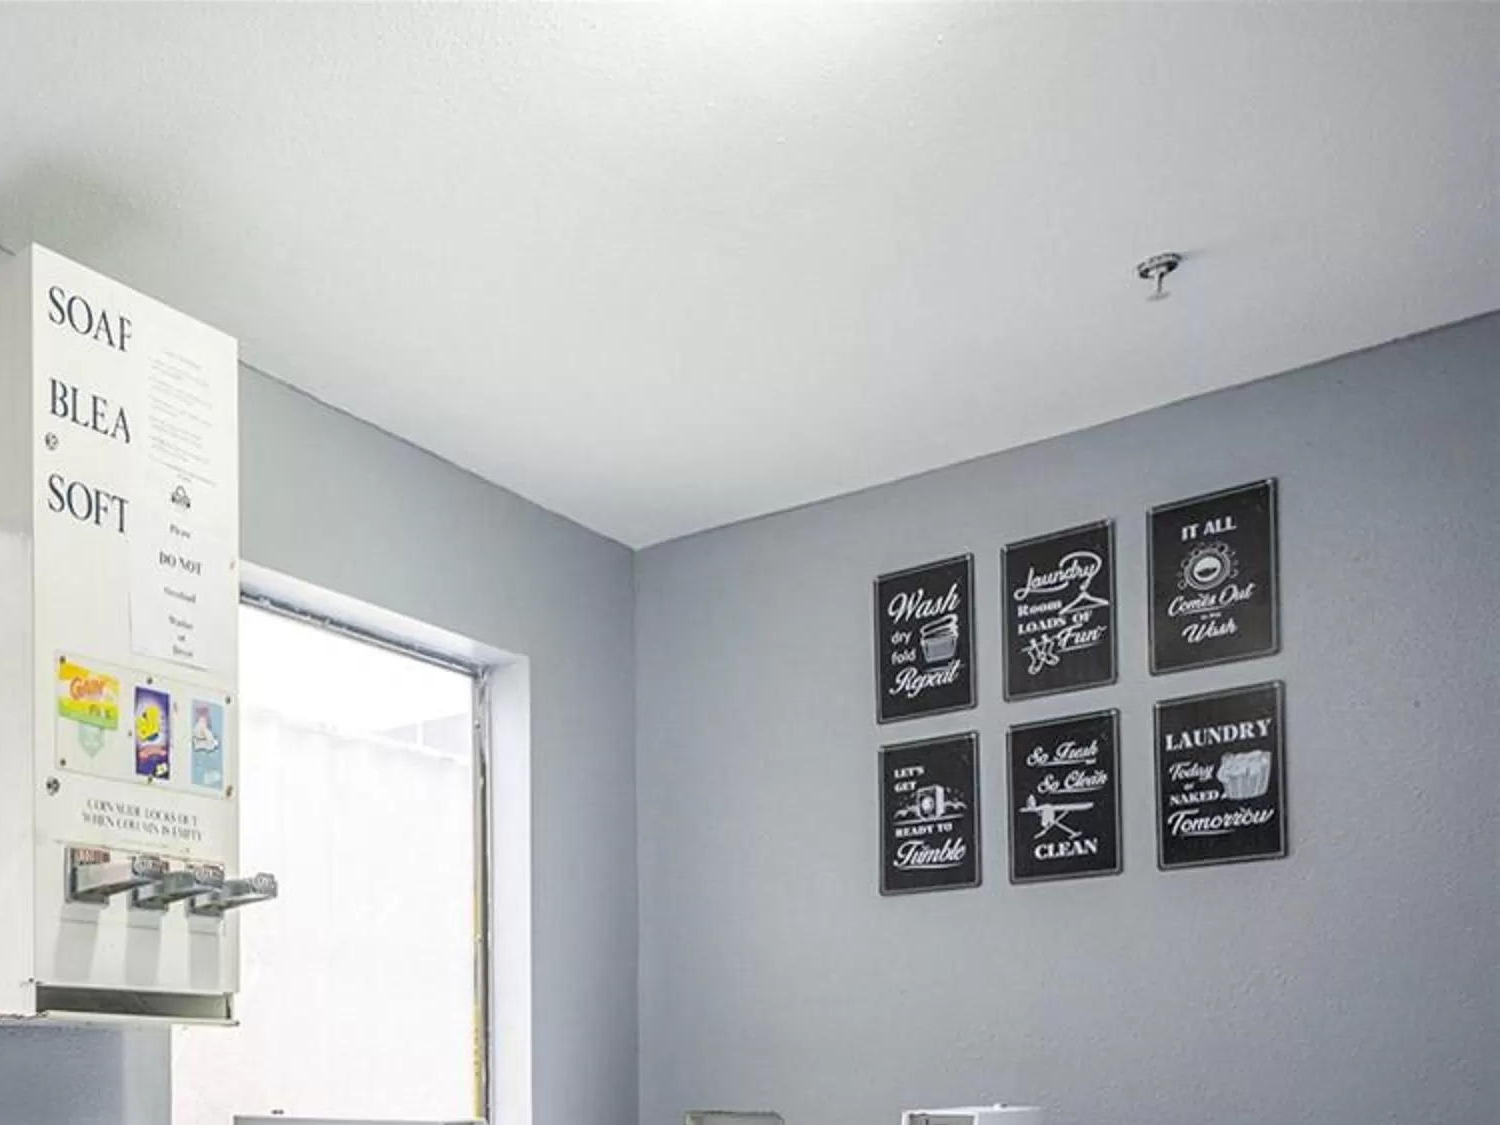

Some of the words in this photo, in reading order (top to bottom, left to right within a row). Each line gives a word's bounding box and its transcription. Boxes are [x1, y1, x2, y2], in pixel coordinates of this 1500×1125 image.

[49, 377, 131, 444] BLEA
[48, 473, 129, 533] SOFT
[1181, 523, 1200, 541] IT
[1203, 516, 1237, 536] ALL
[159, 551, 176, 568] DO
[180, 557, 202, 576] NOT
[1014, 551, 1102, 600] Laundry
[887, 583, 960, 624] Wash
[1219, 582, 1256, 604] Out
[891, 630, 912, 645] dry
[1017, 617, 1066, 635] LOADS
[1057, 624, 1107, 649] Fun
[1181, 618, 1239, 643] Wash
[891, 648, 916, 665] fold
[889, 659, 961, 698] Repeat
[1165, 718, 1272, 751] LAUNDRY
[1026, 746, 1049, 767] So
[1054, 740, 1098, 762] Fresh
[1037, 774, 1060, 793] So
[1064, 769, 1108, 790] Clean
[1169, 761, 1214, 781] Today
[894, 781, 917, 793] GET
[1169, 790, 1220, 806] NAKED
[895, 824, 934, 837] READY
[937, 823, 953, 833] TO
[1167, 807, 1275, 835] Tomorrow
[893, 837, 966, 867] Tumble
[1034, 837, 1098, 860] CLEAN
